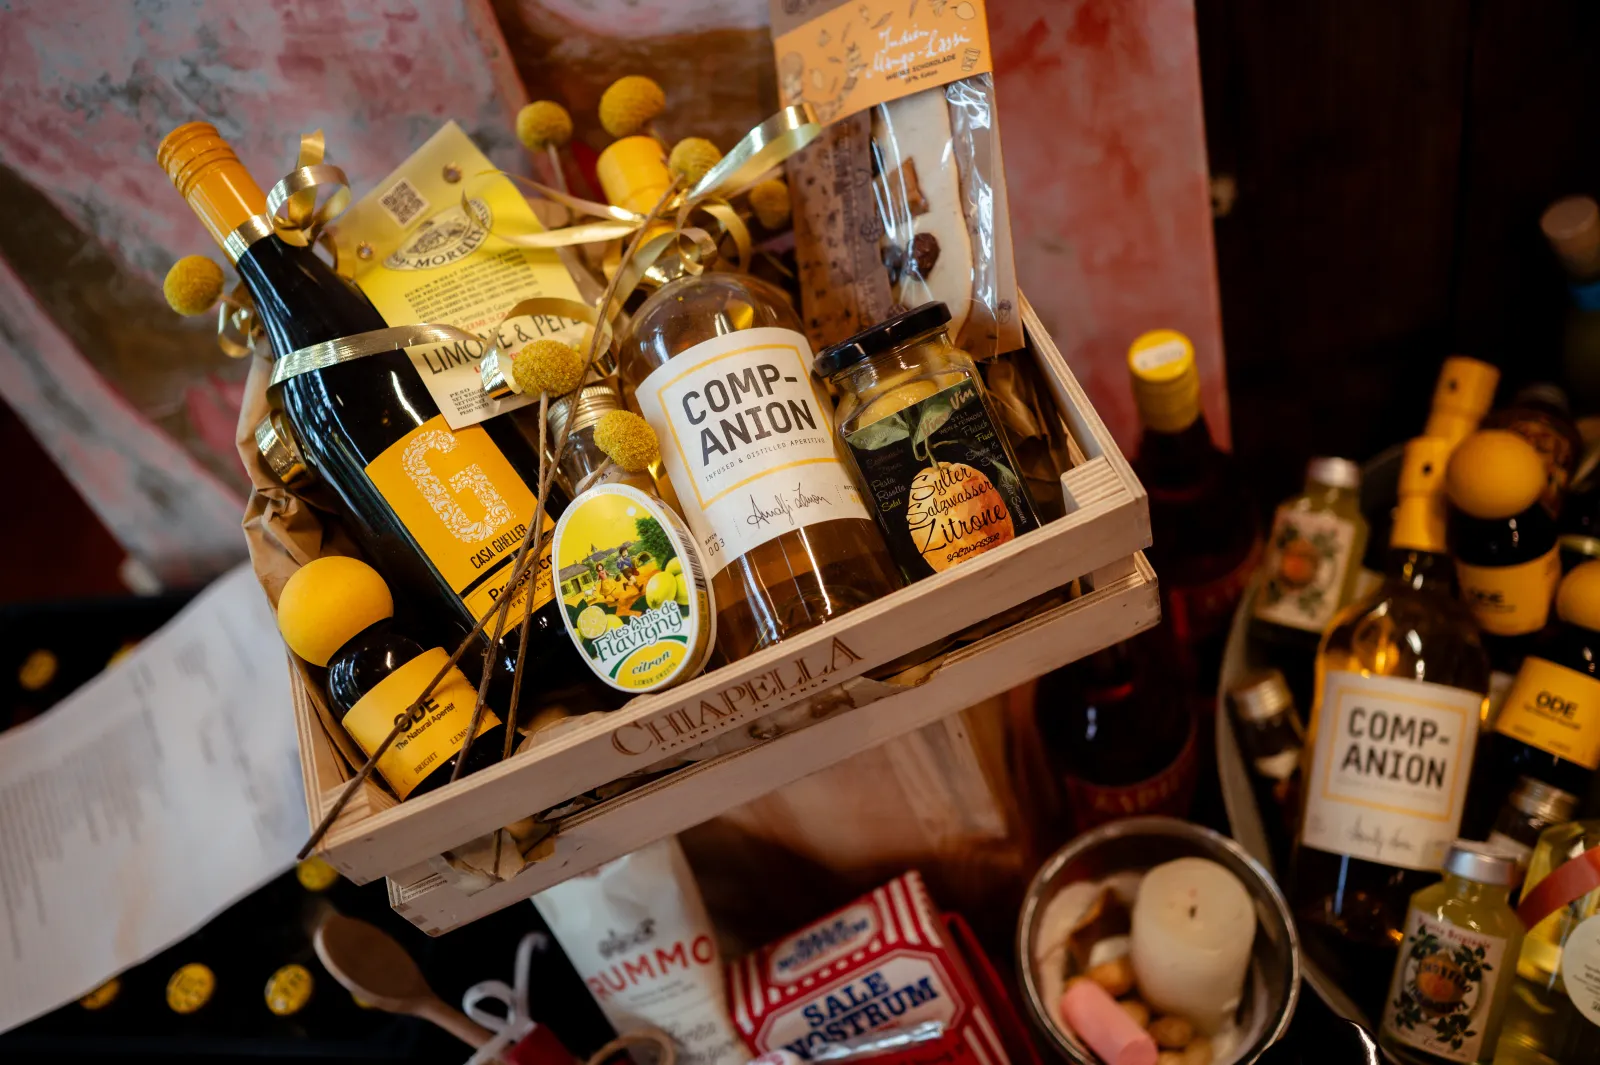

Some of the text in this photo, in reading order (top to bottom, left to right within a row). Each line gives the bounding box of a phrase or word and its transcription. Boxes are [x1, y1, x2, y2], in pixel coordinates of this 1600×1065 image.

[911, 53, 957, 72] SCHOKOLADE
[514, 323, 534, 343] &
[529, 314, 584, 338] PEE
[682, 363, 798, 426] COMP-
[697, 399, 818, 467] ANION
[704, 461, 736, 483] INFUSED
[737, 456, 745, 465] &
[746, 441, 787, 461] DISTILLED
[910, 465, 972, 501] Sylter
[402, 429, 517, 544] G
[906, 480, 995, 526] Salzwasser
[469, 523, 528, 570] CASA GHELLER
[704, 532, 718, 546] BATCH
[708, 537, 726, 557] 003
[908, 504, 1008, 557] Zitrone
[594, 609, 683, 663] Flavigny
[614, 623, 630, 638] les
[629, 607, 661, 631] Anis
[661, 600, 678, 618] de
[631, 649, 671, 676] citron
[393, 697, 440, 733] ODE
[611, 635, 865, 757] CHIAPELLA
[1535, 690, 1579, 720] ODE
[394, 701, 456, 751] The Natural Aperitif
[449, 726, 470, 745] LEMO
[1347, 706, 1450, 749] COMP-
[413, 751, 438, 775] BRIGHT
[1340, 741, 1448, 790] ANION
[585, 933, 716, 1001] RUMMO
[802, 970, 890, 1029] SALE
